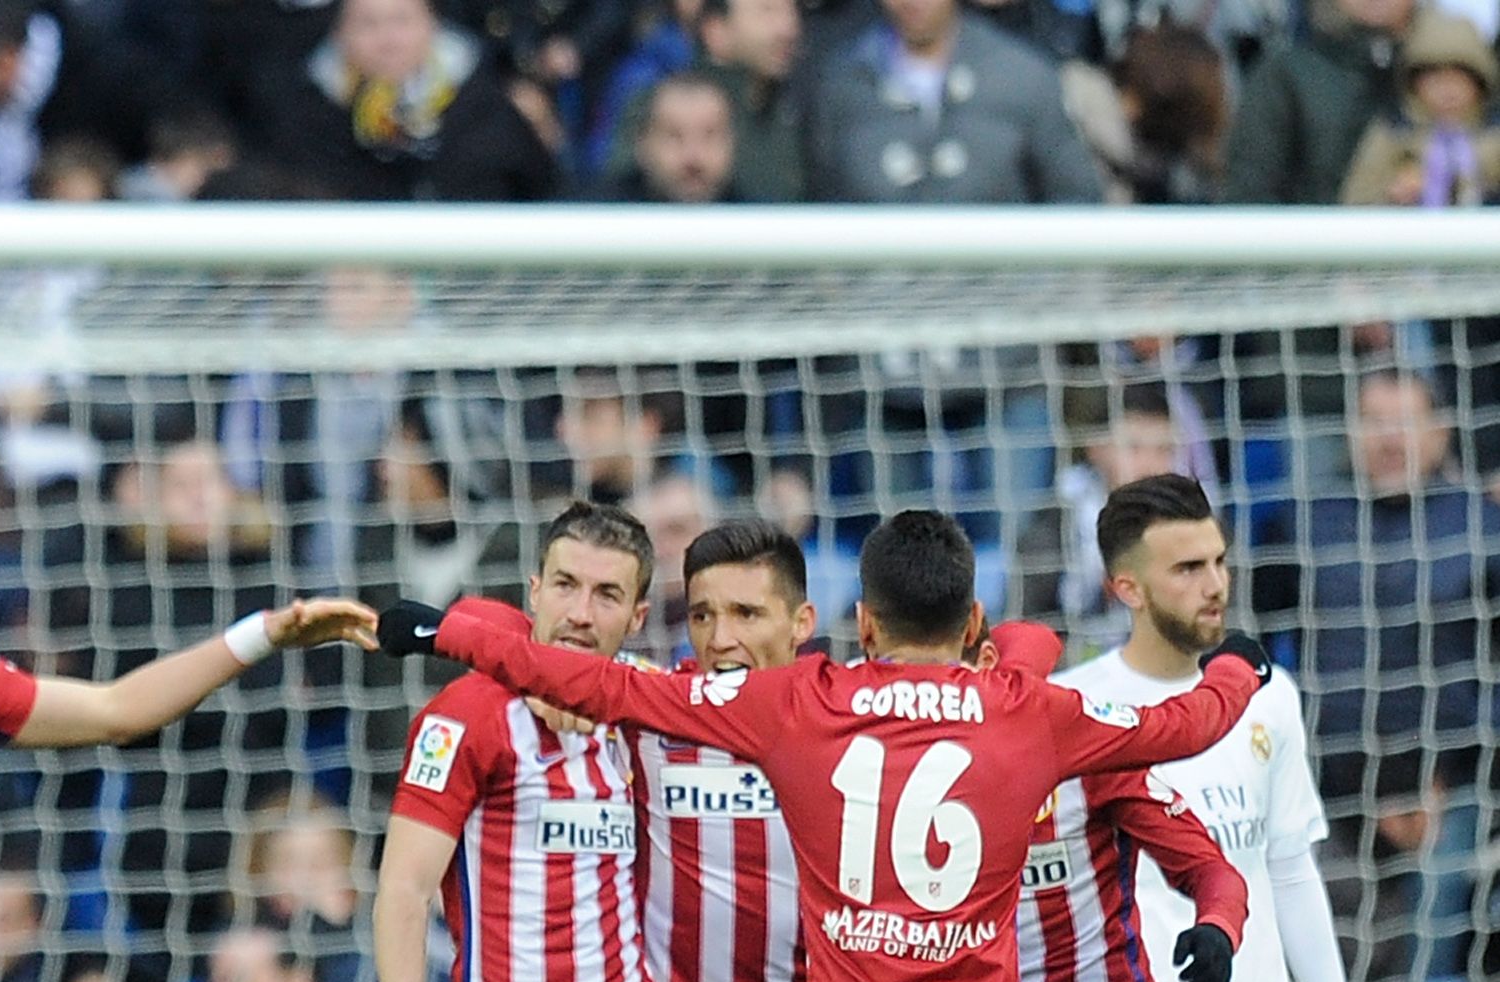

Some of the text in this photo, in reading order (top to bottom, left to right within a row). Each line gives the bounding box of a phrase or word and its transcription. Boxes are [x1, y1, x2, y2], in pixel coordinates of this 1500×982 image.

[851, 679, 984, 723] CORREA
[1202, 785, 1245, 811] Fly
[831, 735, 982, 912] 16
[833, 904, 996, 959] AZERBAIJAN
[839, 935, 947, 962] LAND OF FIRE
